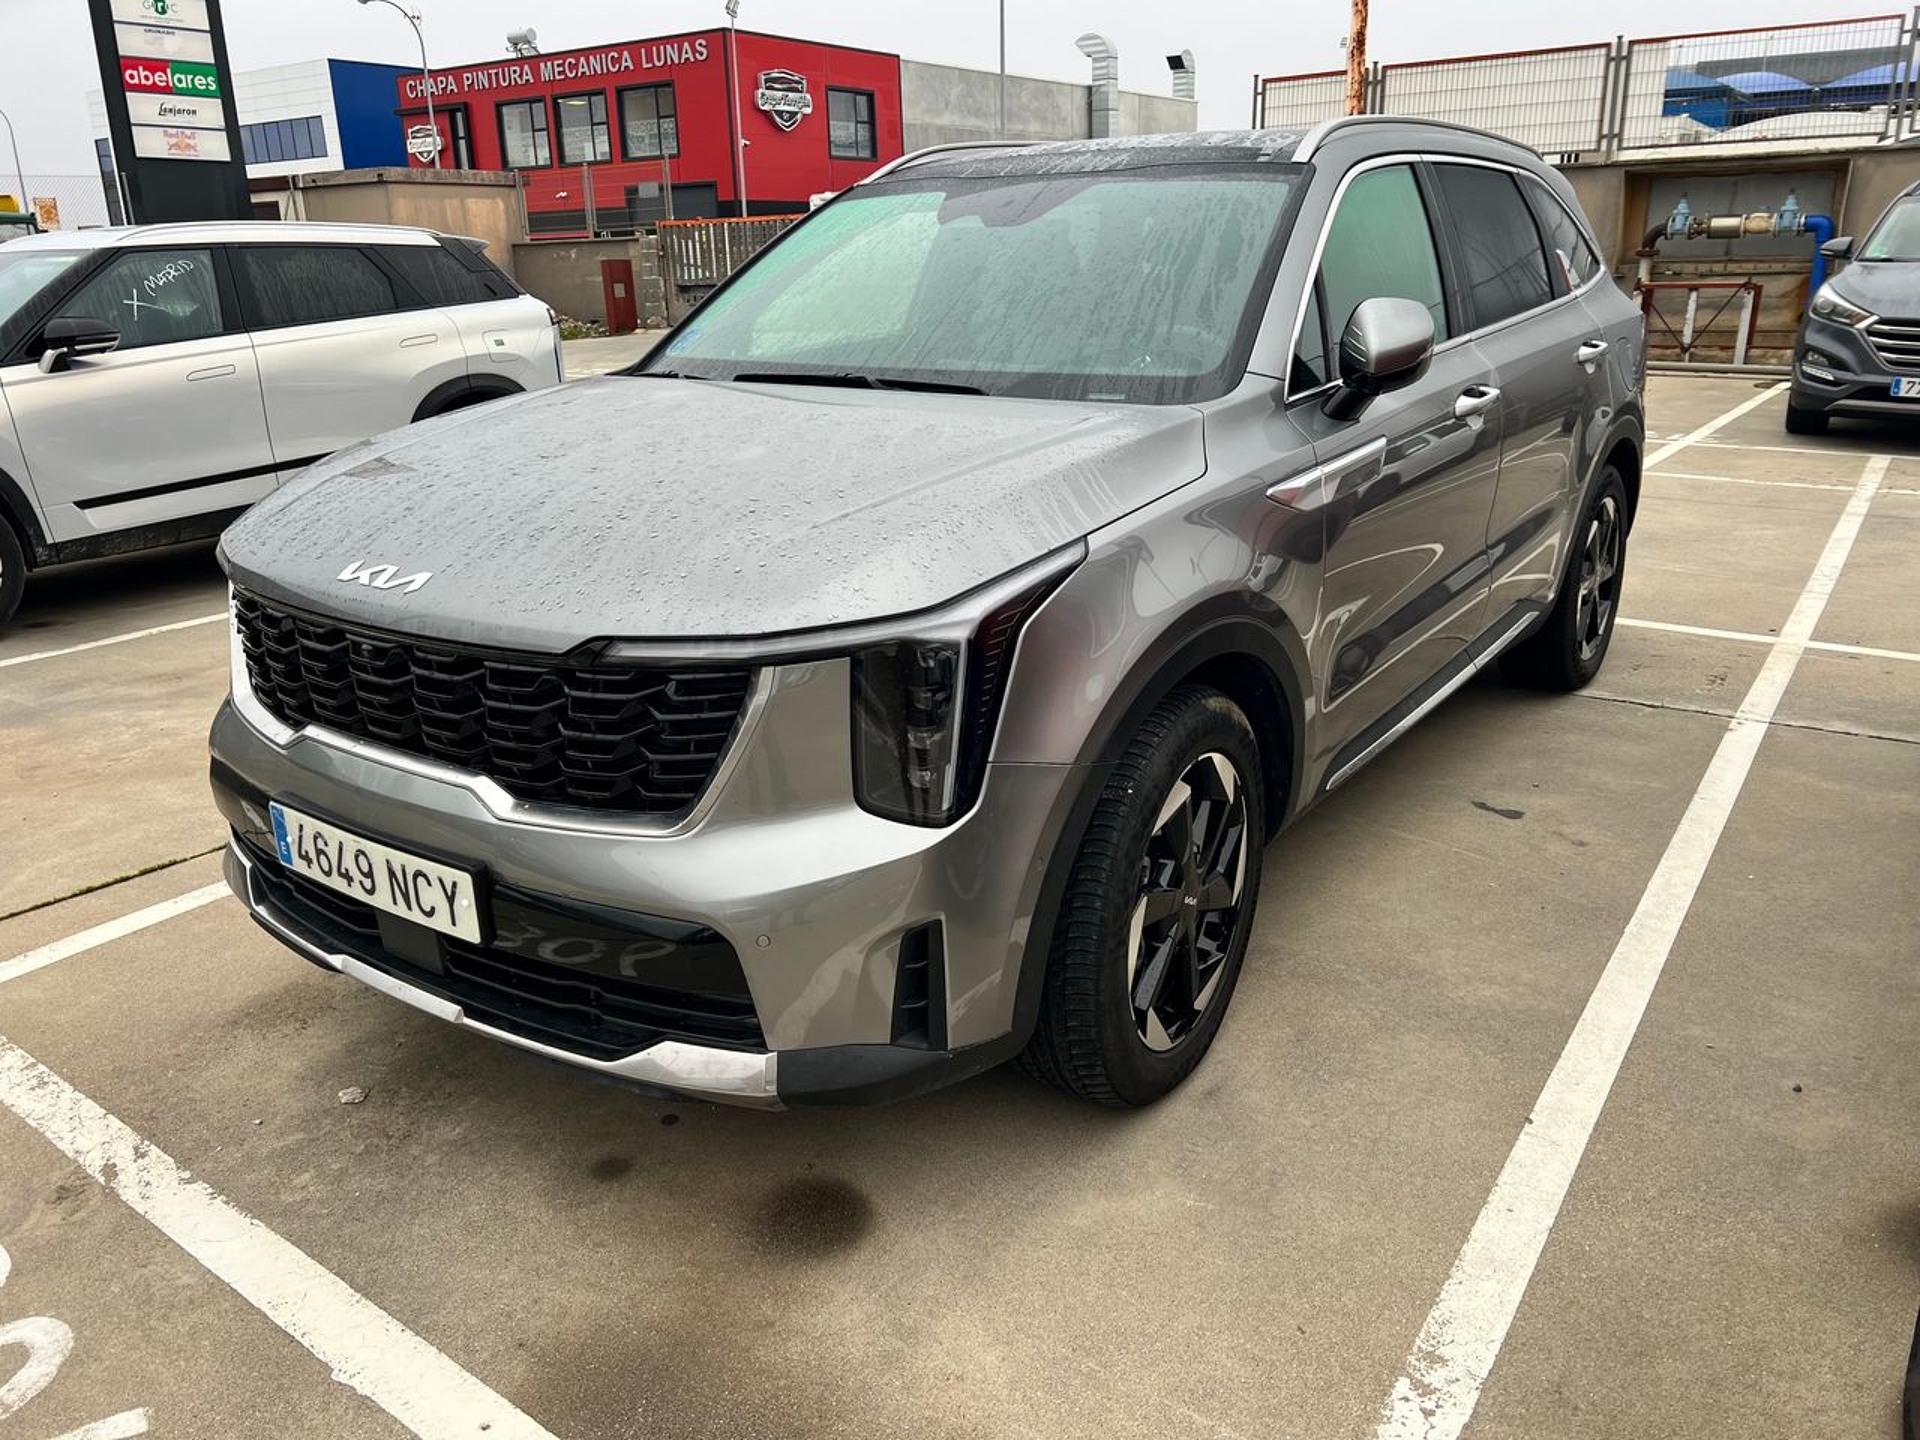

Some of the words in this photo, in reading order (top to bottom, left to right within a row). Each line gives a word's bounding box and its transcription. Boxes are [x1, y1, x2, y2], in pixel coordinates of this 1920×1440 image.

[124, 66, 216, 90] abelares
[406, 75, 458, 98] CHAPA
[463, 64, 534, 92] PINTURA
[540, 51, 633, 82] MECANICA
[642, 39, 707, 69] LUNAS
[144, 260, 194, 296] MADRID
[336, 559, 434, 594] KIA
[297, 824, 376, 896] 4649
[385, 858, 457, 927] NCY
